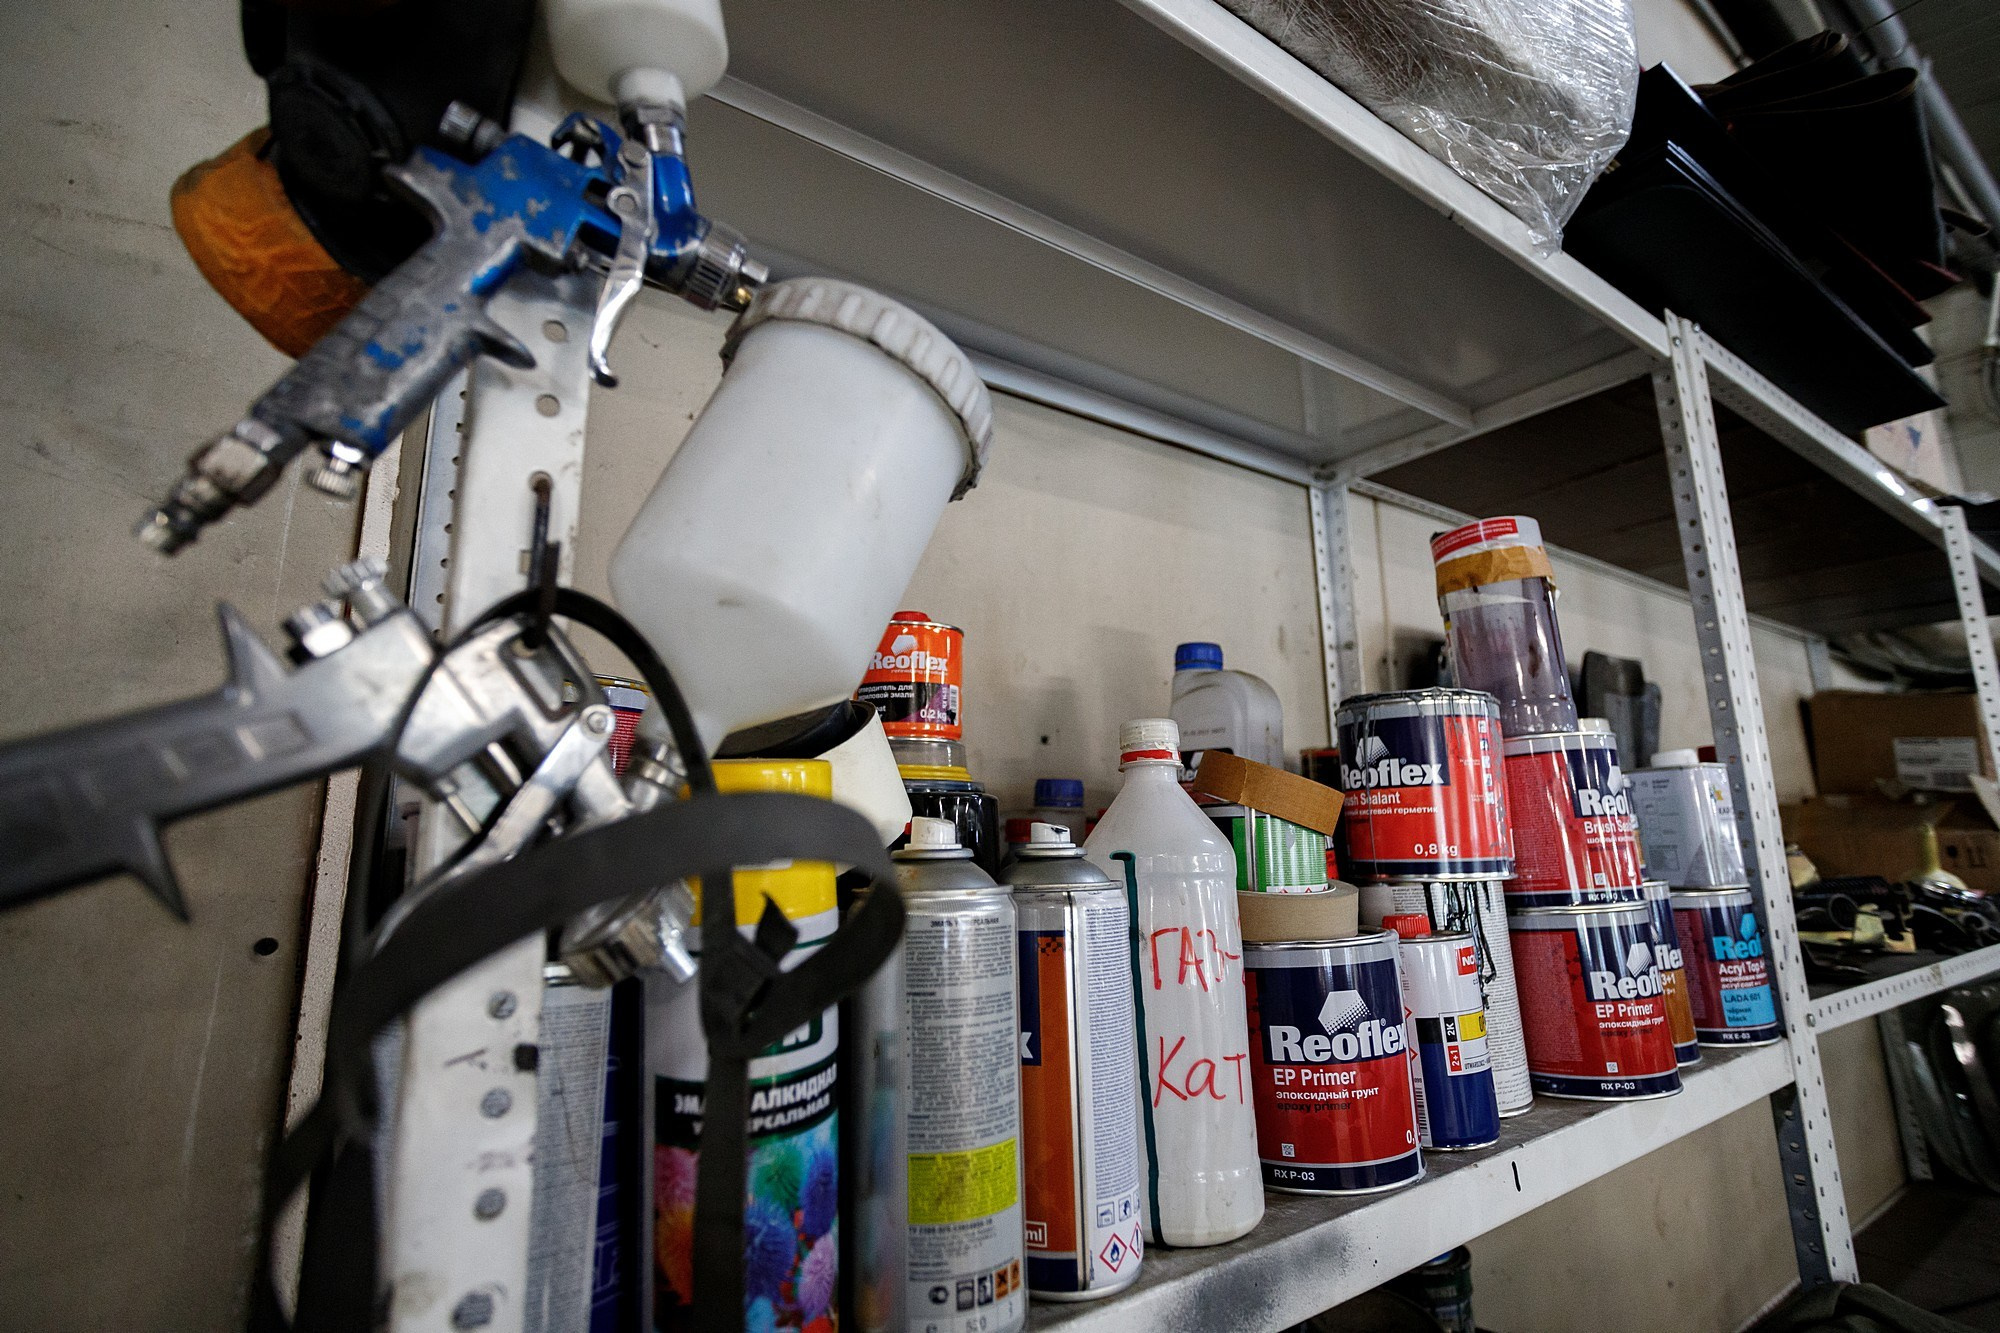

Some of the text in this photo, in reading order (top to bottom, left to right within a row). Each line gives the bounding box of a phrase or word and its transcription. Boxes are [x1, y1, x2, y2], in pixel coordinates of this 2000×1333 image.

[868, 651, 948, 671] Reoflex
[1340, 758, 1445, 790] Reoflex
[1413, 843, 1438, 857] 0,8
[1719, 961, 1746, 977] Acryl
[1724, 994, 1749, 1004] LADA
[1596, 1002, 1653, 1019] EP Primer
[1446, 1022, 1456, 1036] 2K
[1599, 1017, 1651, 1029] эпоксидный
[1269, 1019, 1407, 1063] Reoflex
[1450, 1049, 1460, 1067] 2+1
[1273, 1068, 1357, 1086] EP Primer
[1601, 1082, 1636, 1091] RX P-03
[1276, 1087, 1379, 1101] эпоксидный грунт
[1278, 1101, 1351, 1113] epoxy primer
[1274, 1169, 1316, 1181] RX P-03
